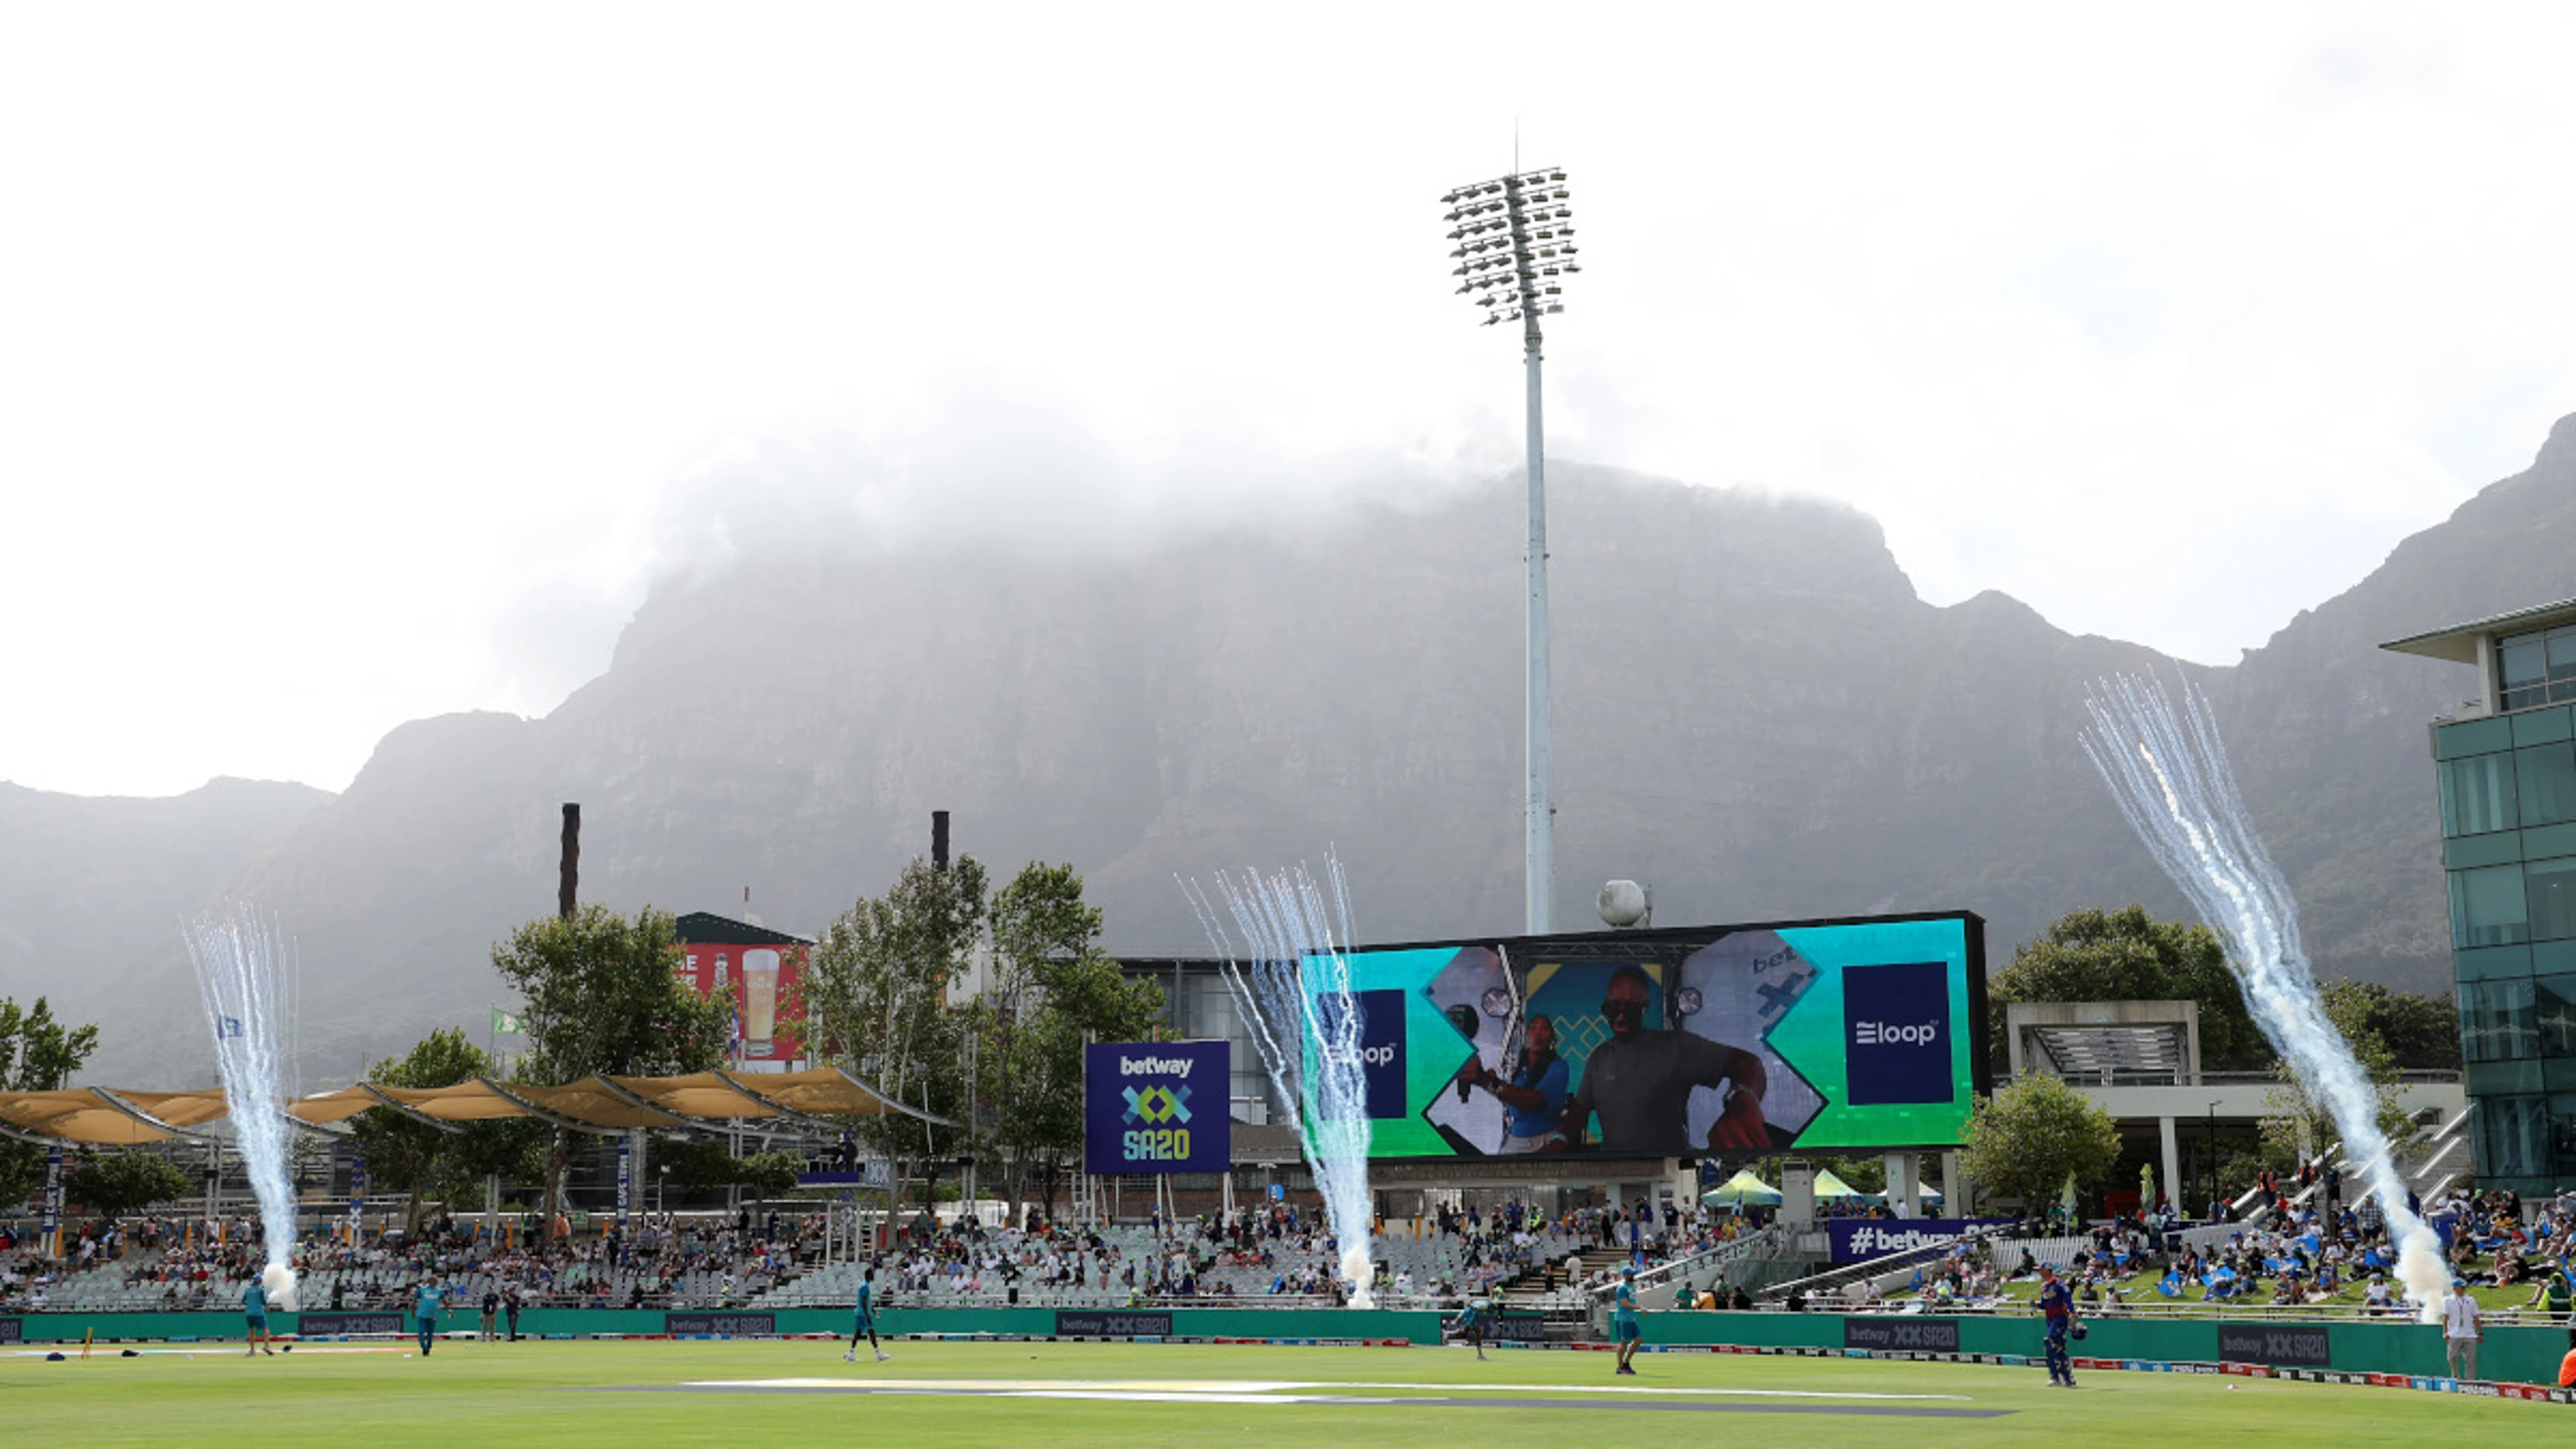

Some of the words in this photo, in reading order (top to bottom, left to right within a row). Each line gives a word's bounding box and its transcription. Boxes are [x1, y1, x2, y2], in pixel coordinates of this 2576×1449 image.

[1120, 1056, 1193, 1078] betway
[1123, 1129, 1189, 1160] SA20
[672, 1320, 708, 1333] betway
[1062, 1318, 1102, 1334] betway
[1135, 1317, 1169, 1334] SA20
[1850, 1326, 1890, 1344] betway
[1923, 1326, 1956, 1346] SA20
[2223, 1334, 2262, 1357] betway
